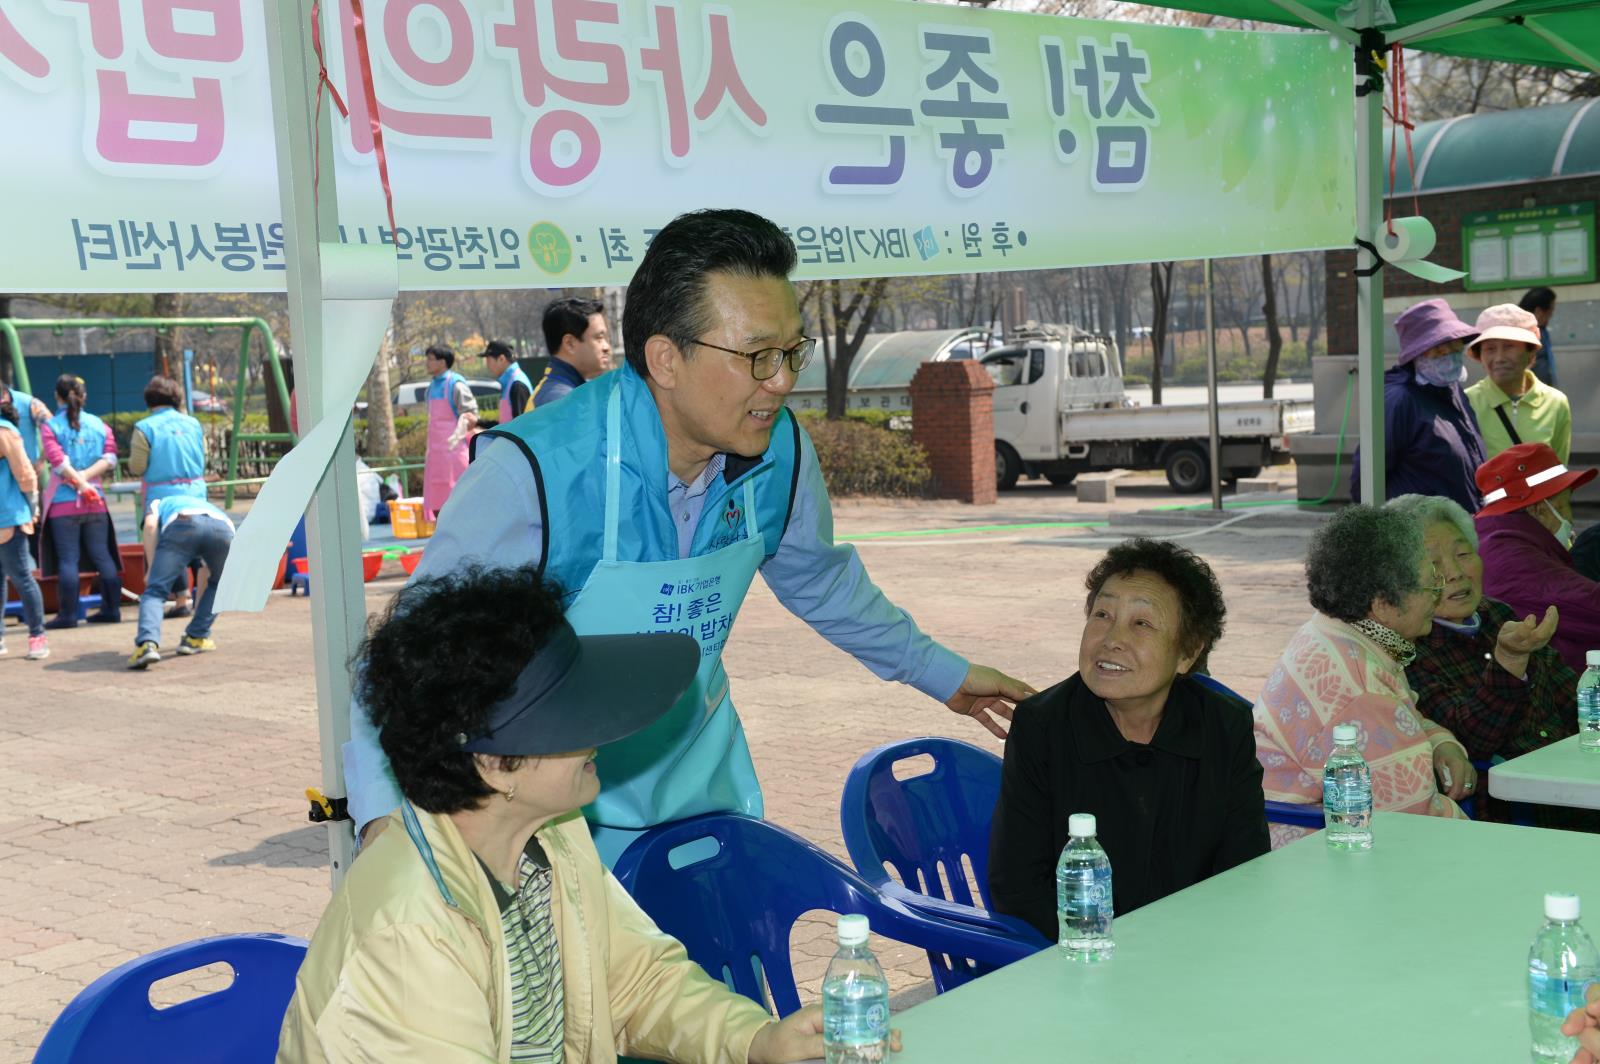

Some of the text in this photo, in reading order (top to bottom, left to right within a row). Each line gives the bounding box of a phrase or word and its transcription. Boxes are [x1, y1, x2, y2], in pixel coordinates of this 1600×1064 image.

[652, 592, 722, 623] 참! 좋은
[700, 612, 732, 641] 밥차
